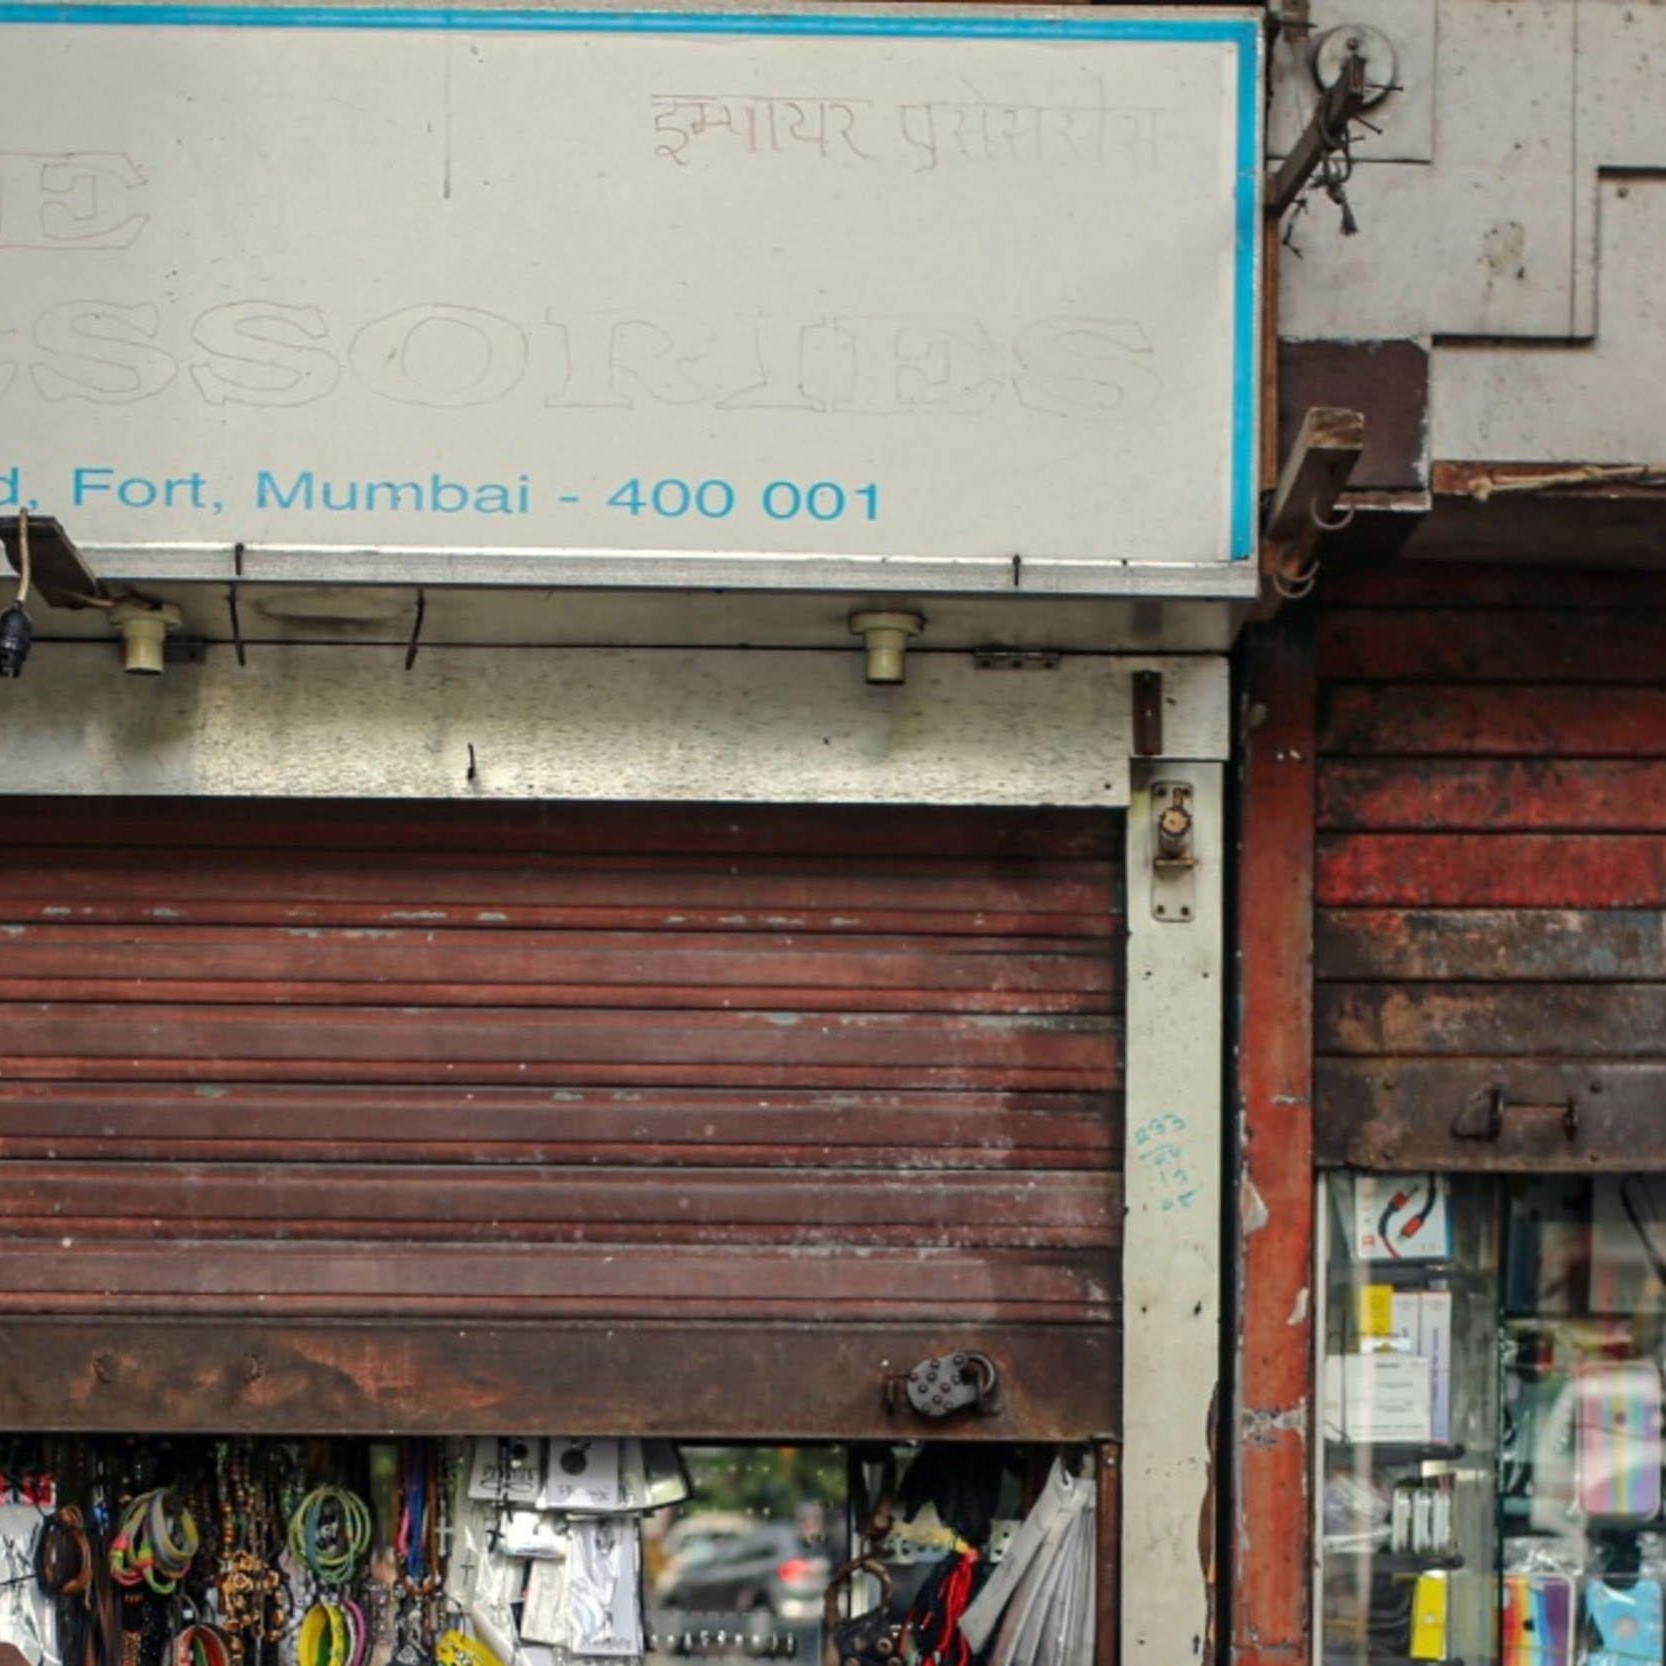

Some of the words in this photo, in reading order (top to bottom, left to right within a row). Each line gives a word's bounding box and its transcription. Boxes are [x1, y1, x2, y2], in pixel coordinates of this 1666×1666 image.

[72, 467, 224, 514] Fort,
[256, 470, 530, 514] Mumbai
[607, 478, 736, 519] 400
[761, 480, 881, 522] 001
